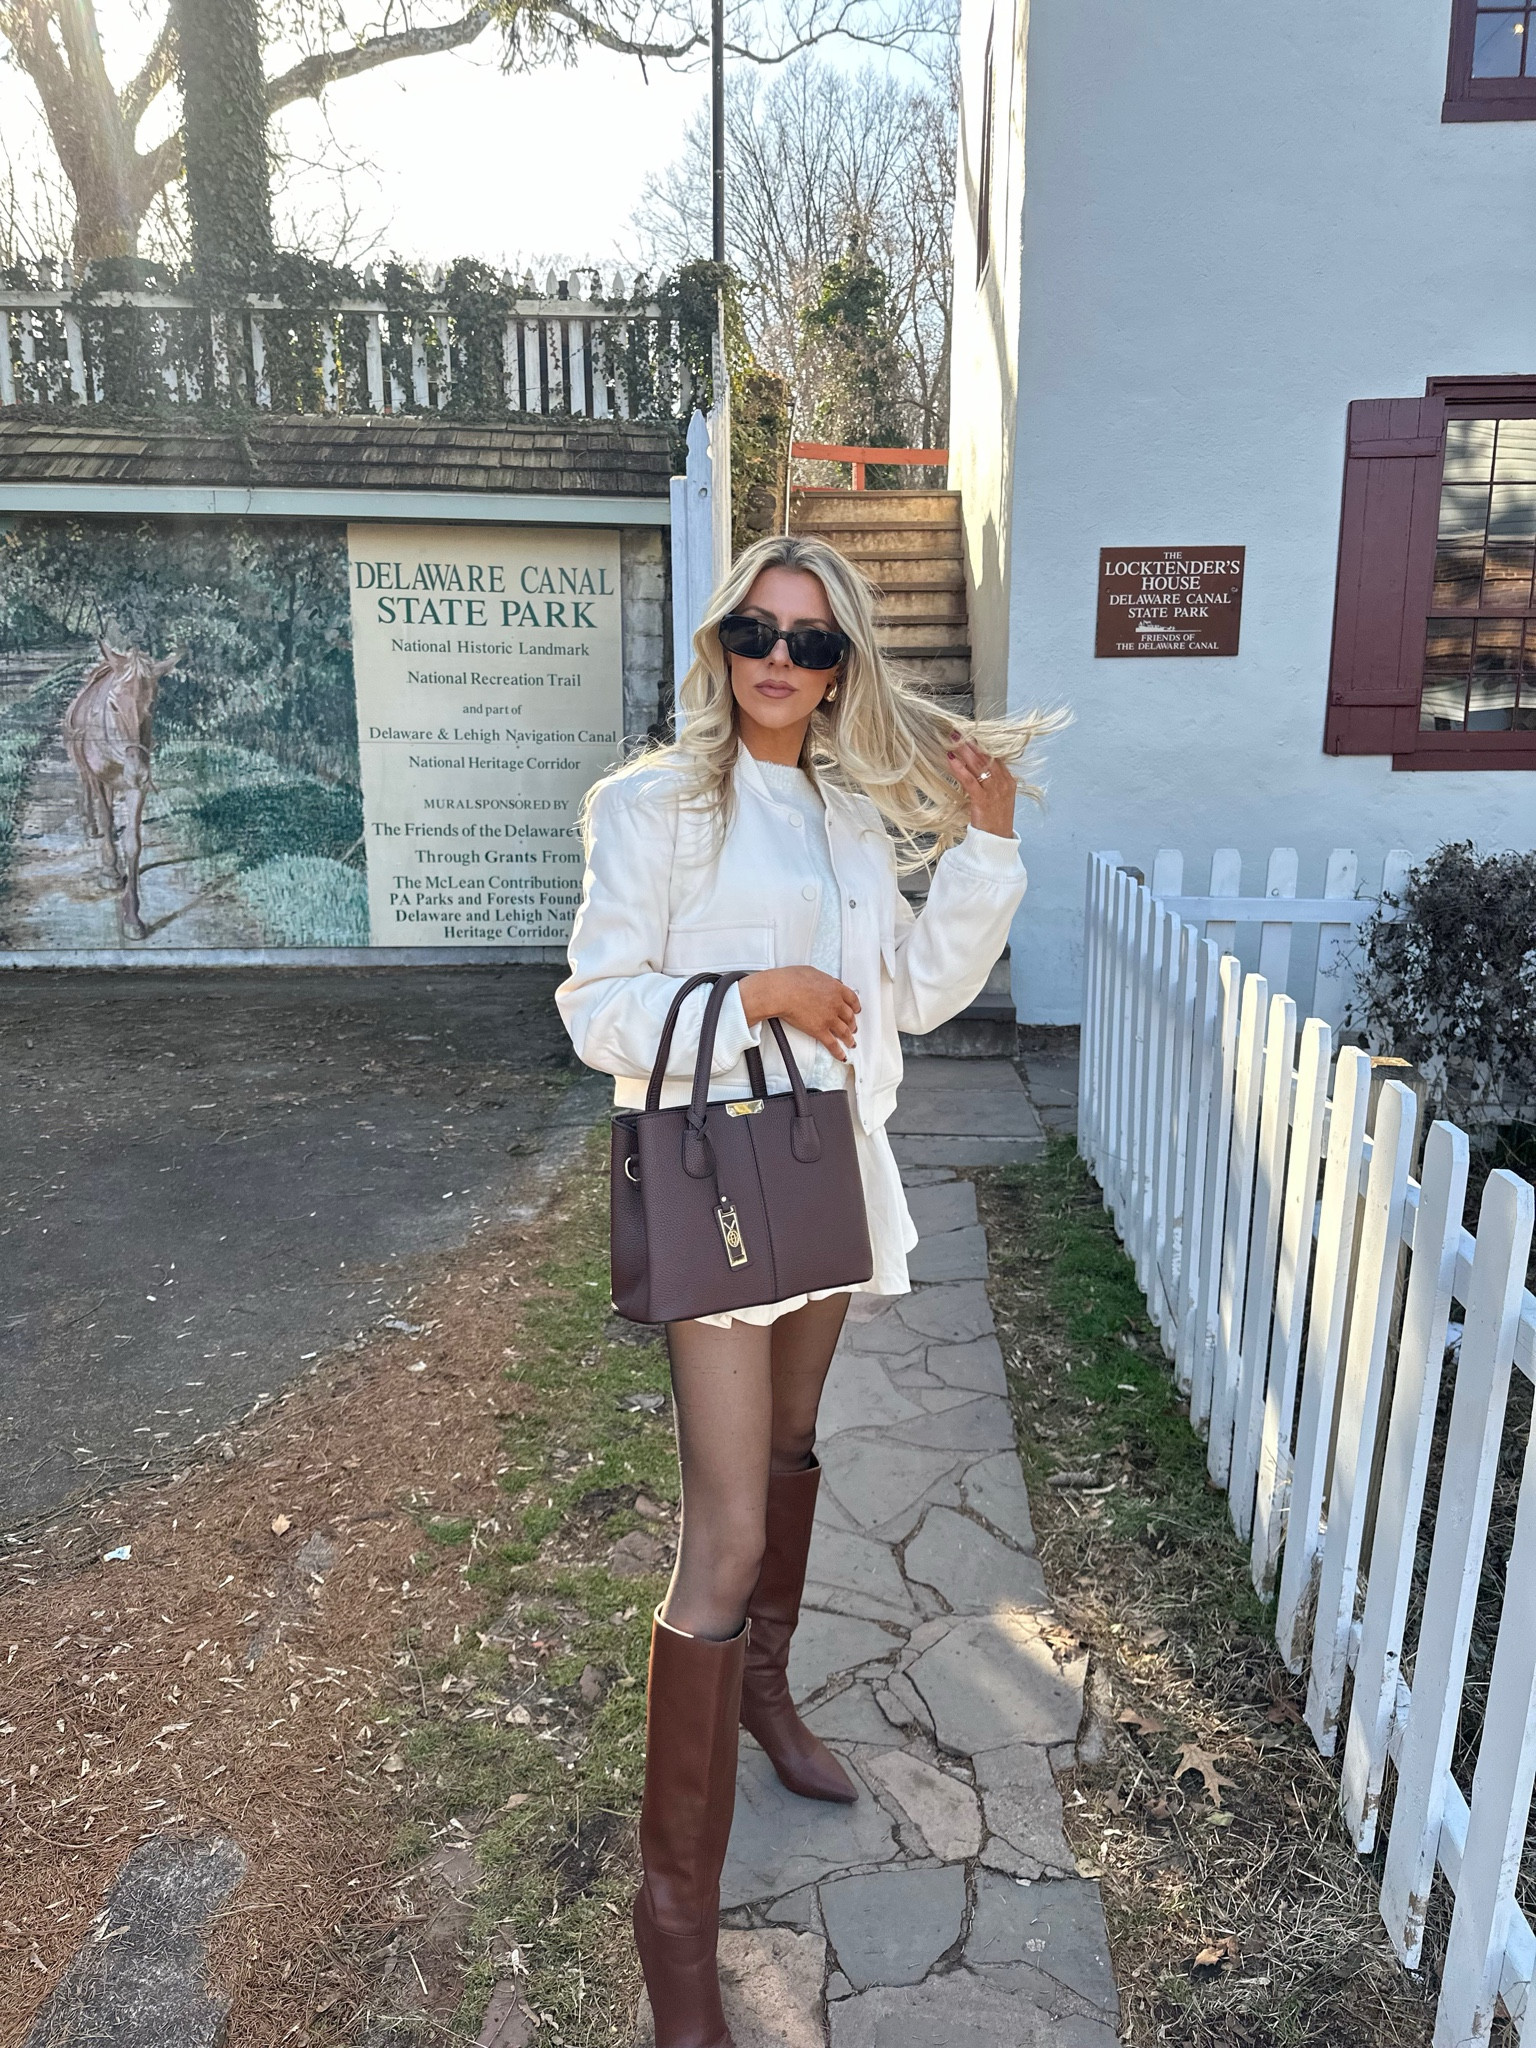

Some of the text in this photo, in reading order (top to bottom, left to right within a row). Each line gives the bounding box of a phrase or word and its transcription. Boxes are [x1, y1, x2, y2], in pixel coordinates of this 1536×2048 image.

[1164, 552, 1182, 560] THE
[355, 562, 614, 595] DELAWARE CANAL
[1141, 576, 1201, 590] HOUSE
[1109, 594, 1231, 605] DELAWARE CANAL
[377, 596, 597, 628] STATE PARK
[1128, 607, 1209, 618] STATE PARK
[1141, 634, 1180, 642] FRIENDS
[391, 639, 589, 656] National Historic Landmark
[407, 671, 581, 687] National Recreation Trail
[462, 704, 522, 717] and part of
[369, 727, 616, 744] Delaware & Lehigh Navigation Canal
[409, 756, 581, 771] National Heritage Corridor
[424, 799, 569, 810] MURAL SPONSORED BY
[372, 823, 401, 836] The
[405, 823, 459, 837] Friends
[462, 825, 477, 837] of
[479, 825, 502, 837] the
[505, 824, 573, 838] Delaware
[415, 850, 580, 866] Through Grants From
[393, 876, 421, 888] The
[425, 876, 485, 888] McLean
[390, 893, 411, 905] PA
[416, 893, 453, 905] Parks
[458, 893, 482, 905] and
[487, 893, 535, 905] Forests
[396, 910, 461, 922] Delaware
[466, 910, 490, 922] and
[496, 910, 542, 924] Lehigh
[444, 926, 502, 940] Heritage
